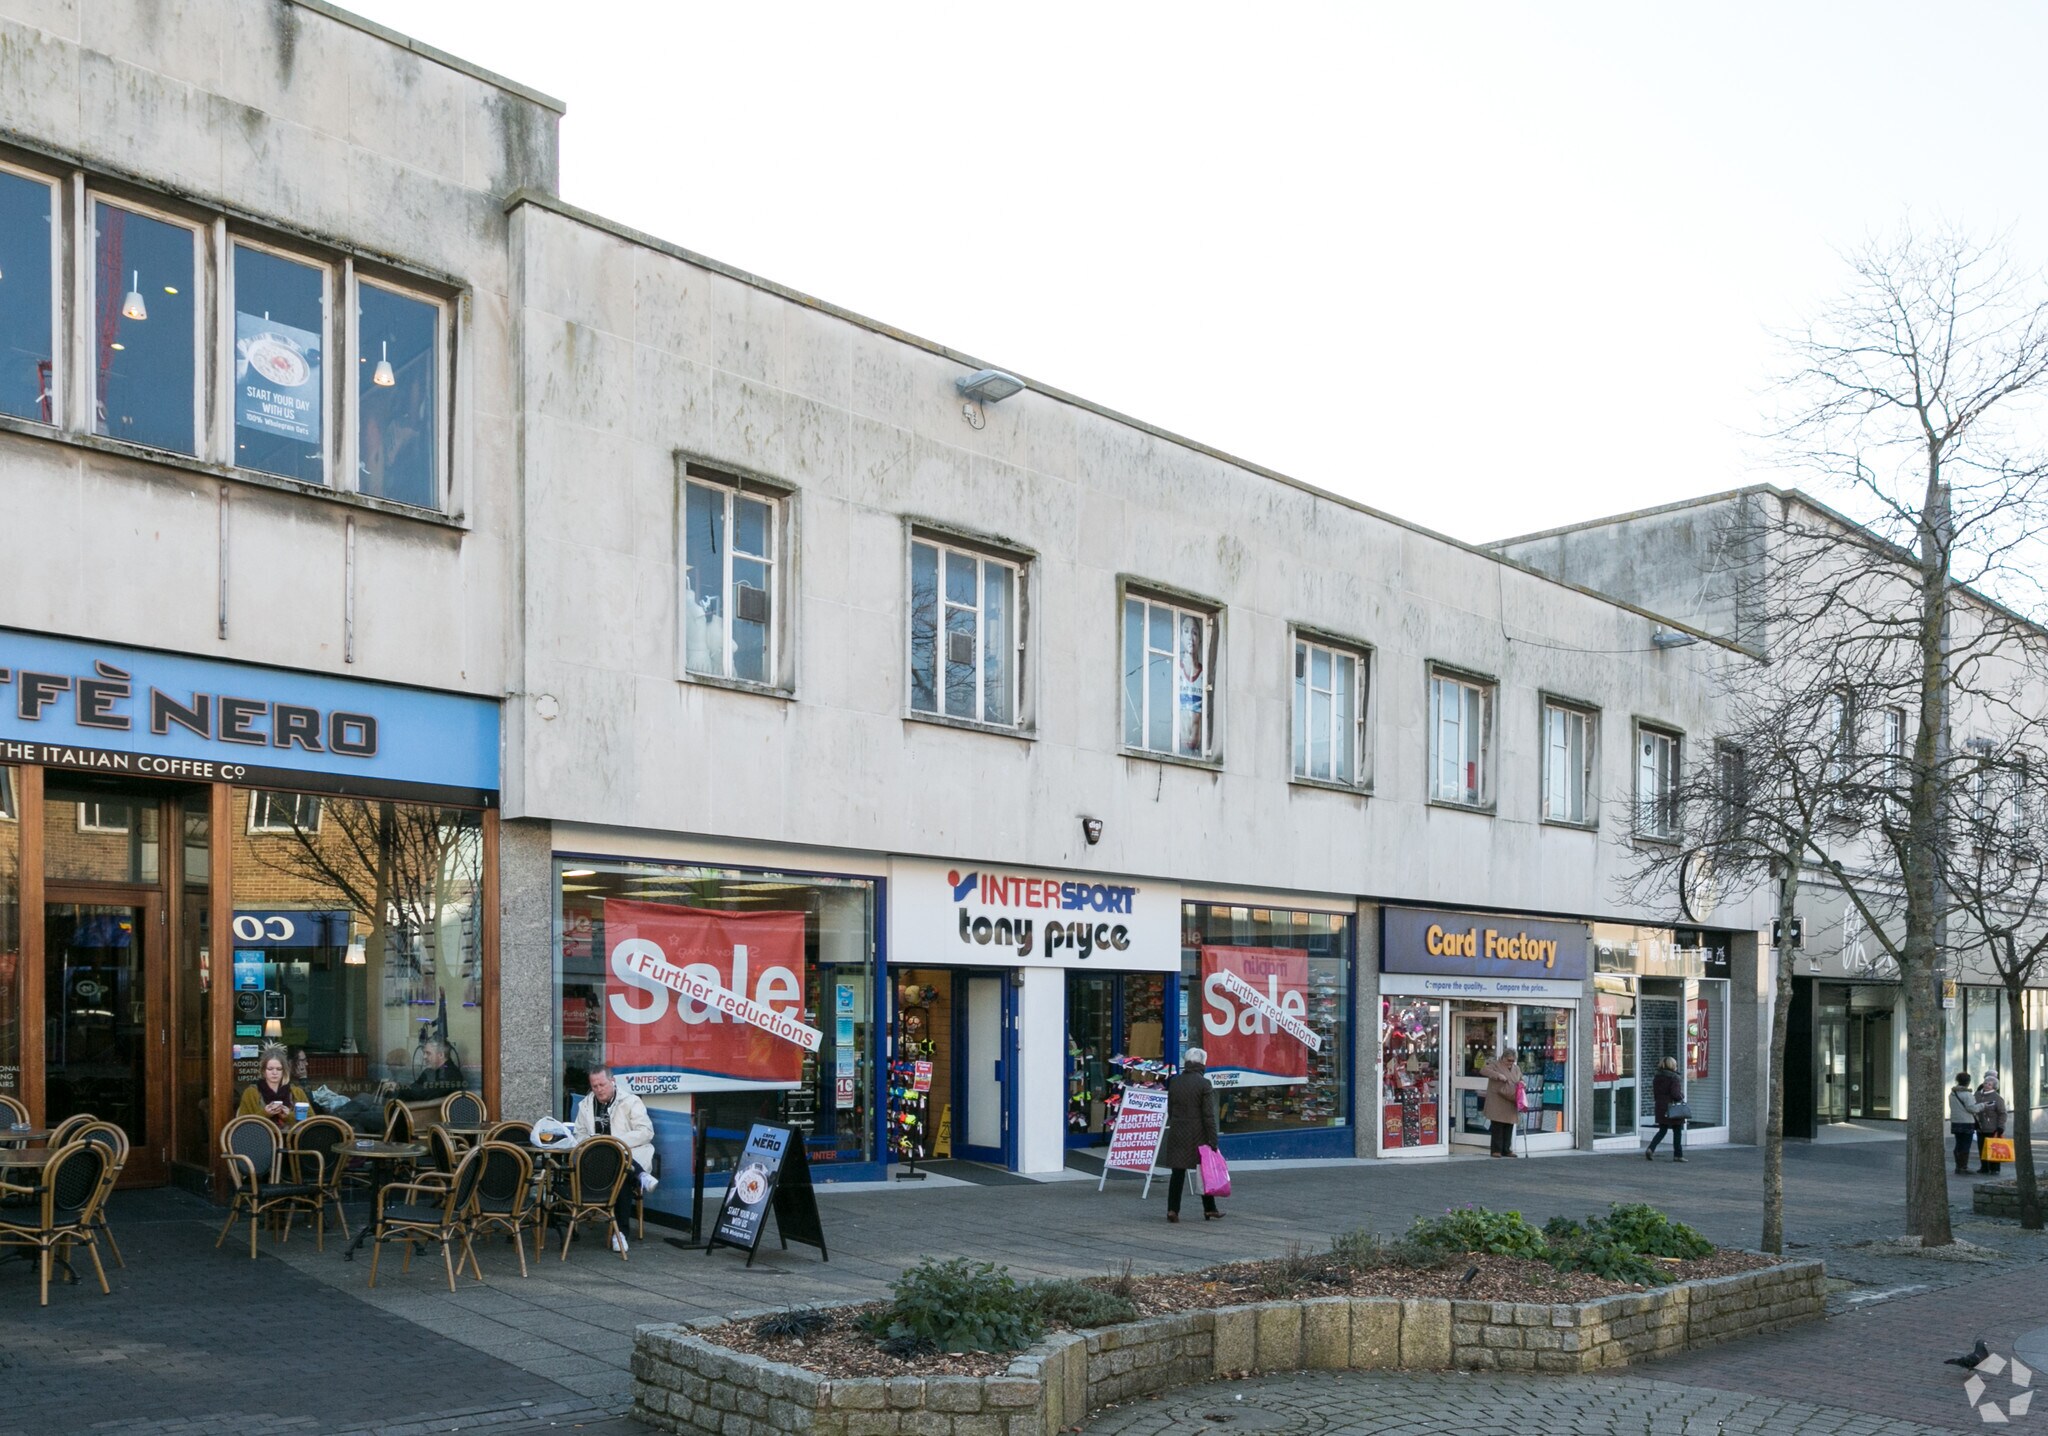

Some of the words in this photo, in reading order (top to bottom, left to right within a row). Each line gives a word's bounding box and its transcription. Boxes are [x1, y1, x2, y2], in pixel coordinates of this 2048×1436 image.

[246, 386, 272, 402] START
[273, 393, 294, 408] YOUR
[295, 399, 310, 411] DAY
[262, 402, 282, 416] WITH
[284, 408, 295, 420] US
[246, 413, 263, 423] 100%
[264, 418, 294, 432] Wholegrain
[296, 426, 309, 435] Oats
[150, 686, 378, 758] NERO
[43, 746, 129, 769] ITALIAN
[138, 756, 214, 778] COFFEE
[981, 874, 1136, 914] INTERSPORT
[958, 907, 1033, 957] tony
[1044, 920, 1130, 960] pryce
[1426, 924, 1476, 957] Card
[1484, 928, 1557, 968] Factory
[609, 938, 800, 1024] Sale
[1452, 981, 1462, 990] the
[1496, 982, 1520, 992] Compare
[1521, 983, 1530, 991] the
[638, 954, 713, 1001] Further
[716, 992, 815, 1047] reductions
[1202, 972, 1306, 1036] Sale
[1226, 973, 1264, 1009] Further
[1266, 1003, 1317, 1048] reductions
[630, 1084, 652, 1094] tony
[653, 1084, 678, 1093] pryce
[634, 1076, 681, 1084] INTERSPORT
[1128, 1099, 1143, 1108] tony
[1132, 1094, 1168, 1103] INTERSPORT
[1118, 1121, 1162, 1129] REDUCTIONS
[1120, 1113, 1164, 1123] FURTHER
[752, 1137, 781, 1152] NERO
[1113, 1140, 1157, 1148] REDUCTIONS
[1114, 1132, 1158, 1141] FURTHER
[1110, 1150, 1153, 1160] FURTHER
